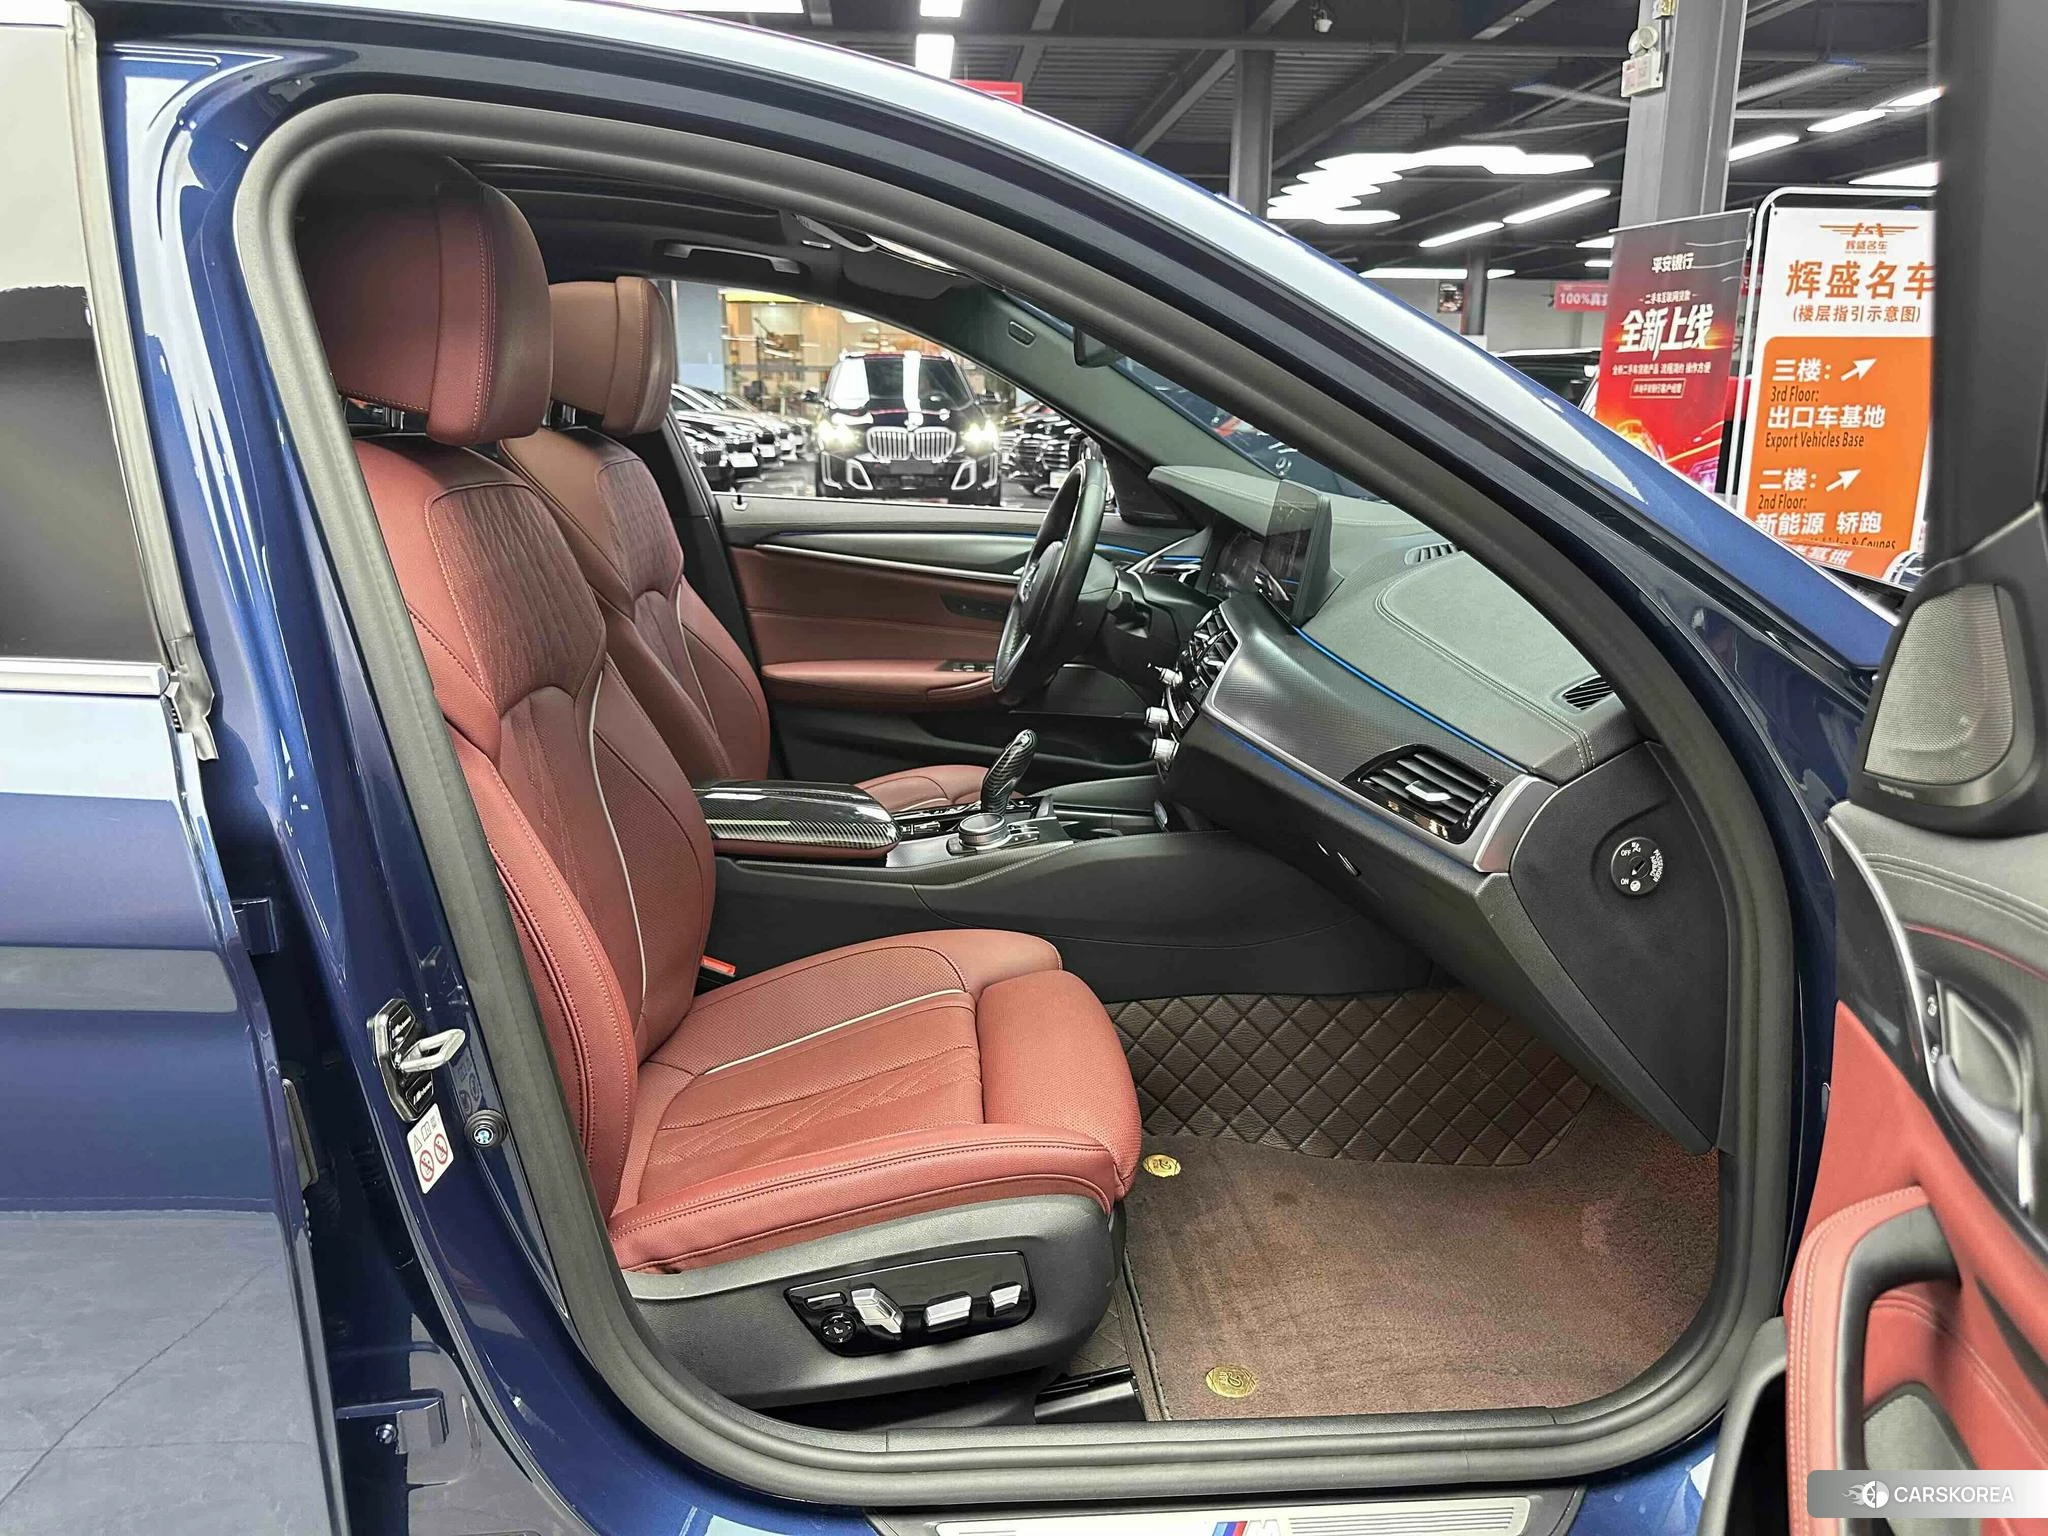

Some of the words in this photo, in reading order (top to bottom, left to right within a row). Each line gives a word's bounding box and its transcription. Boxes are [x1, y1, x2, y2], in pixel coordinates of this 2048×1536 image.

[1652, 252, 1694, 273] 平安银行
[1786, 260, 1936, 300] 辉盛名车
[1616, 303, 1714, 361] 全新上线
[1771, 385, 1788, 402] 3rd
[1789, 386, 1819, 402] Floor:
[1767, 404, 1886, 429] 出口车基地
[1765, 432, 1798, 452] Export
[1800, 431, 1840, 448] Vehicles
[1842, 431, 1865, 448] Base
[1758, 494, 1775, 510] 2nd
[1778, 494, 1808, 510] Floor:
[1756, 512, 1827, 536] 新能源
[1836, 510, 1883, 535] 轿跑
